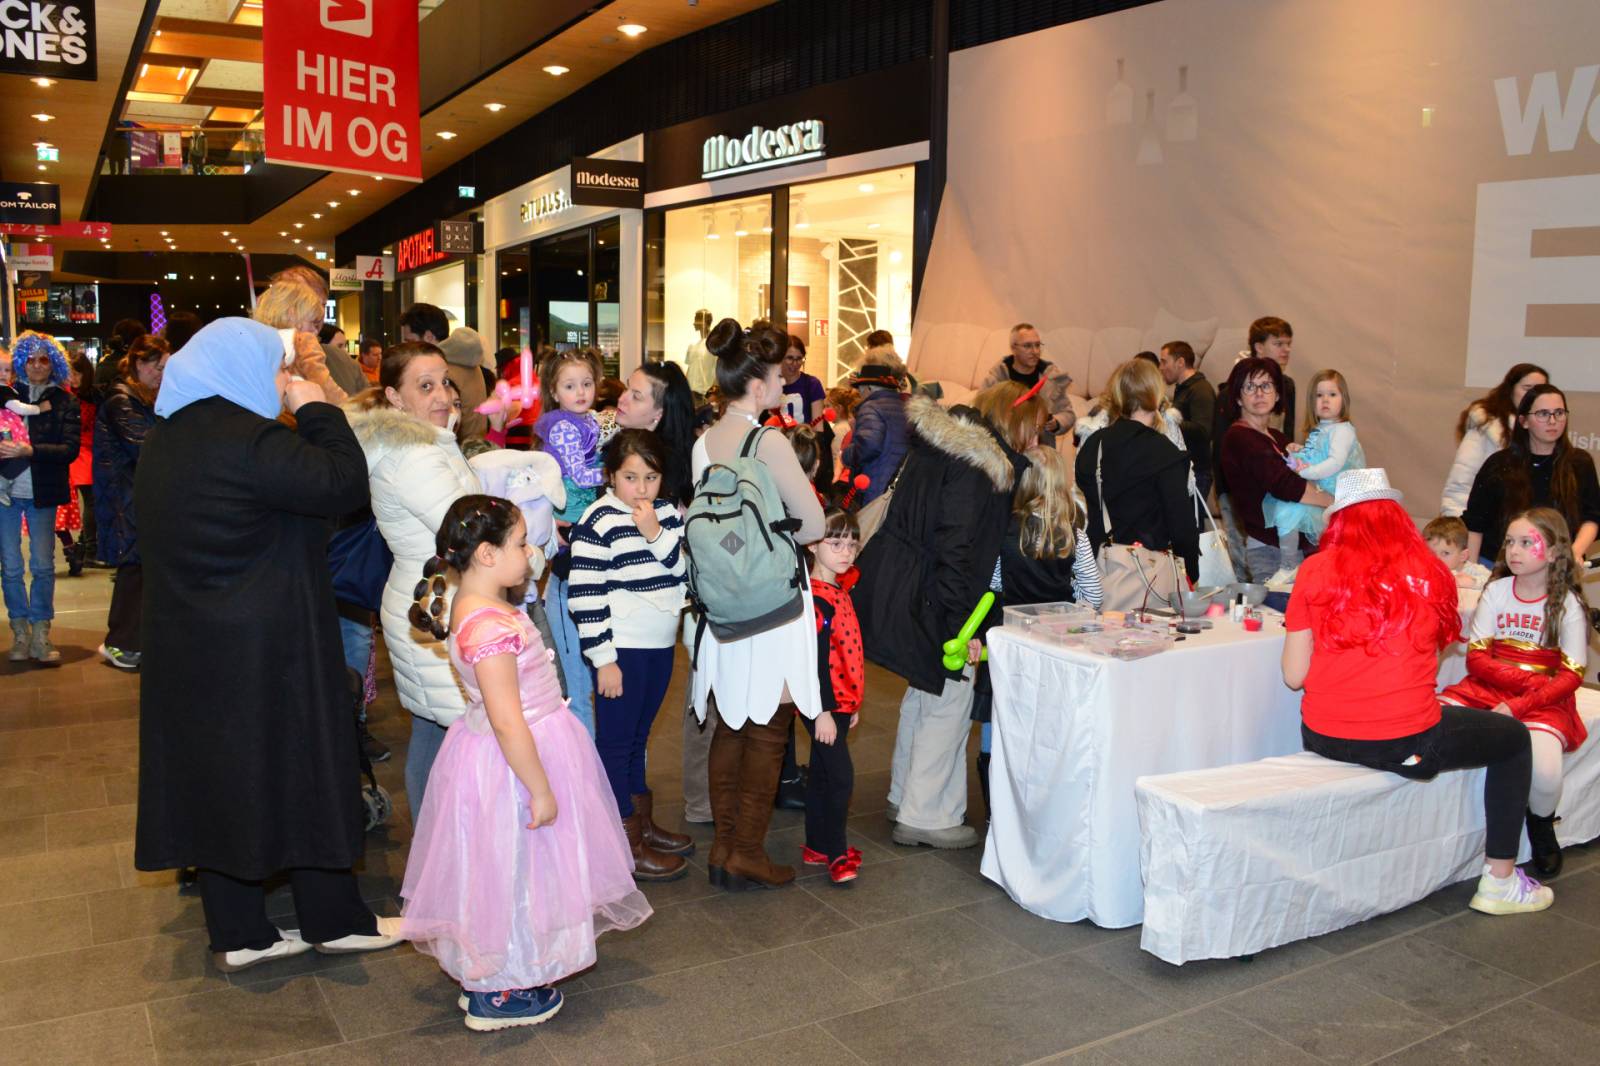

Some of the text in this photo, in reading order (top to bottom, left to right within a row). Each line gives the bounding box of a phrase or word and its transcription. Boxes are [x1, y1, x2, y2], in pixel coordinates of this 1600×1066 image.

[0, 29, 88, 65] NES
[296, 49, 397, 108] HIER
[283, 104, 408, 163] IM OG
[1494, 63, 1600, 157] W
[18, 201, 57, 210] TAILOR
[397, 227, 447, 273] APOTHE
